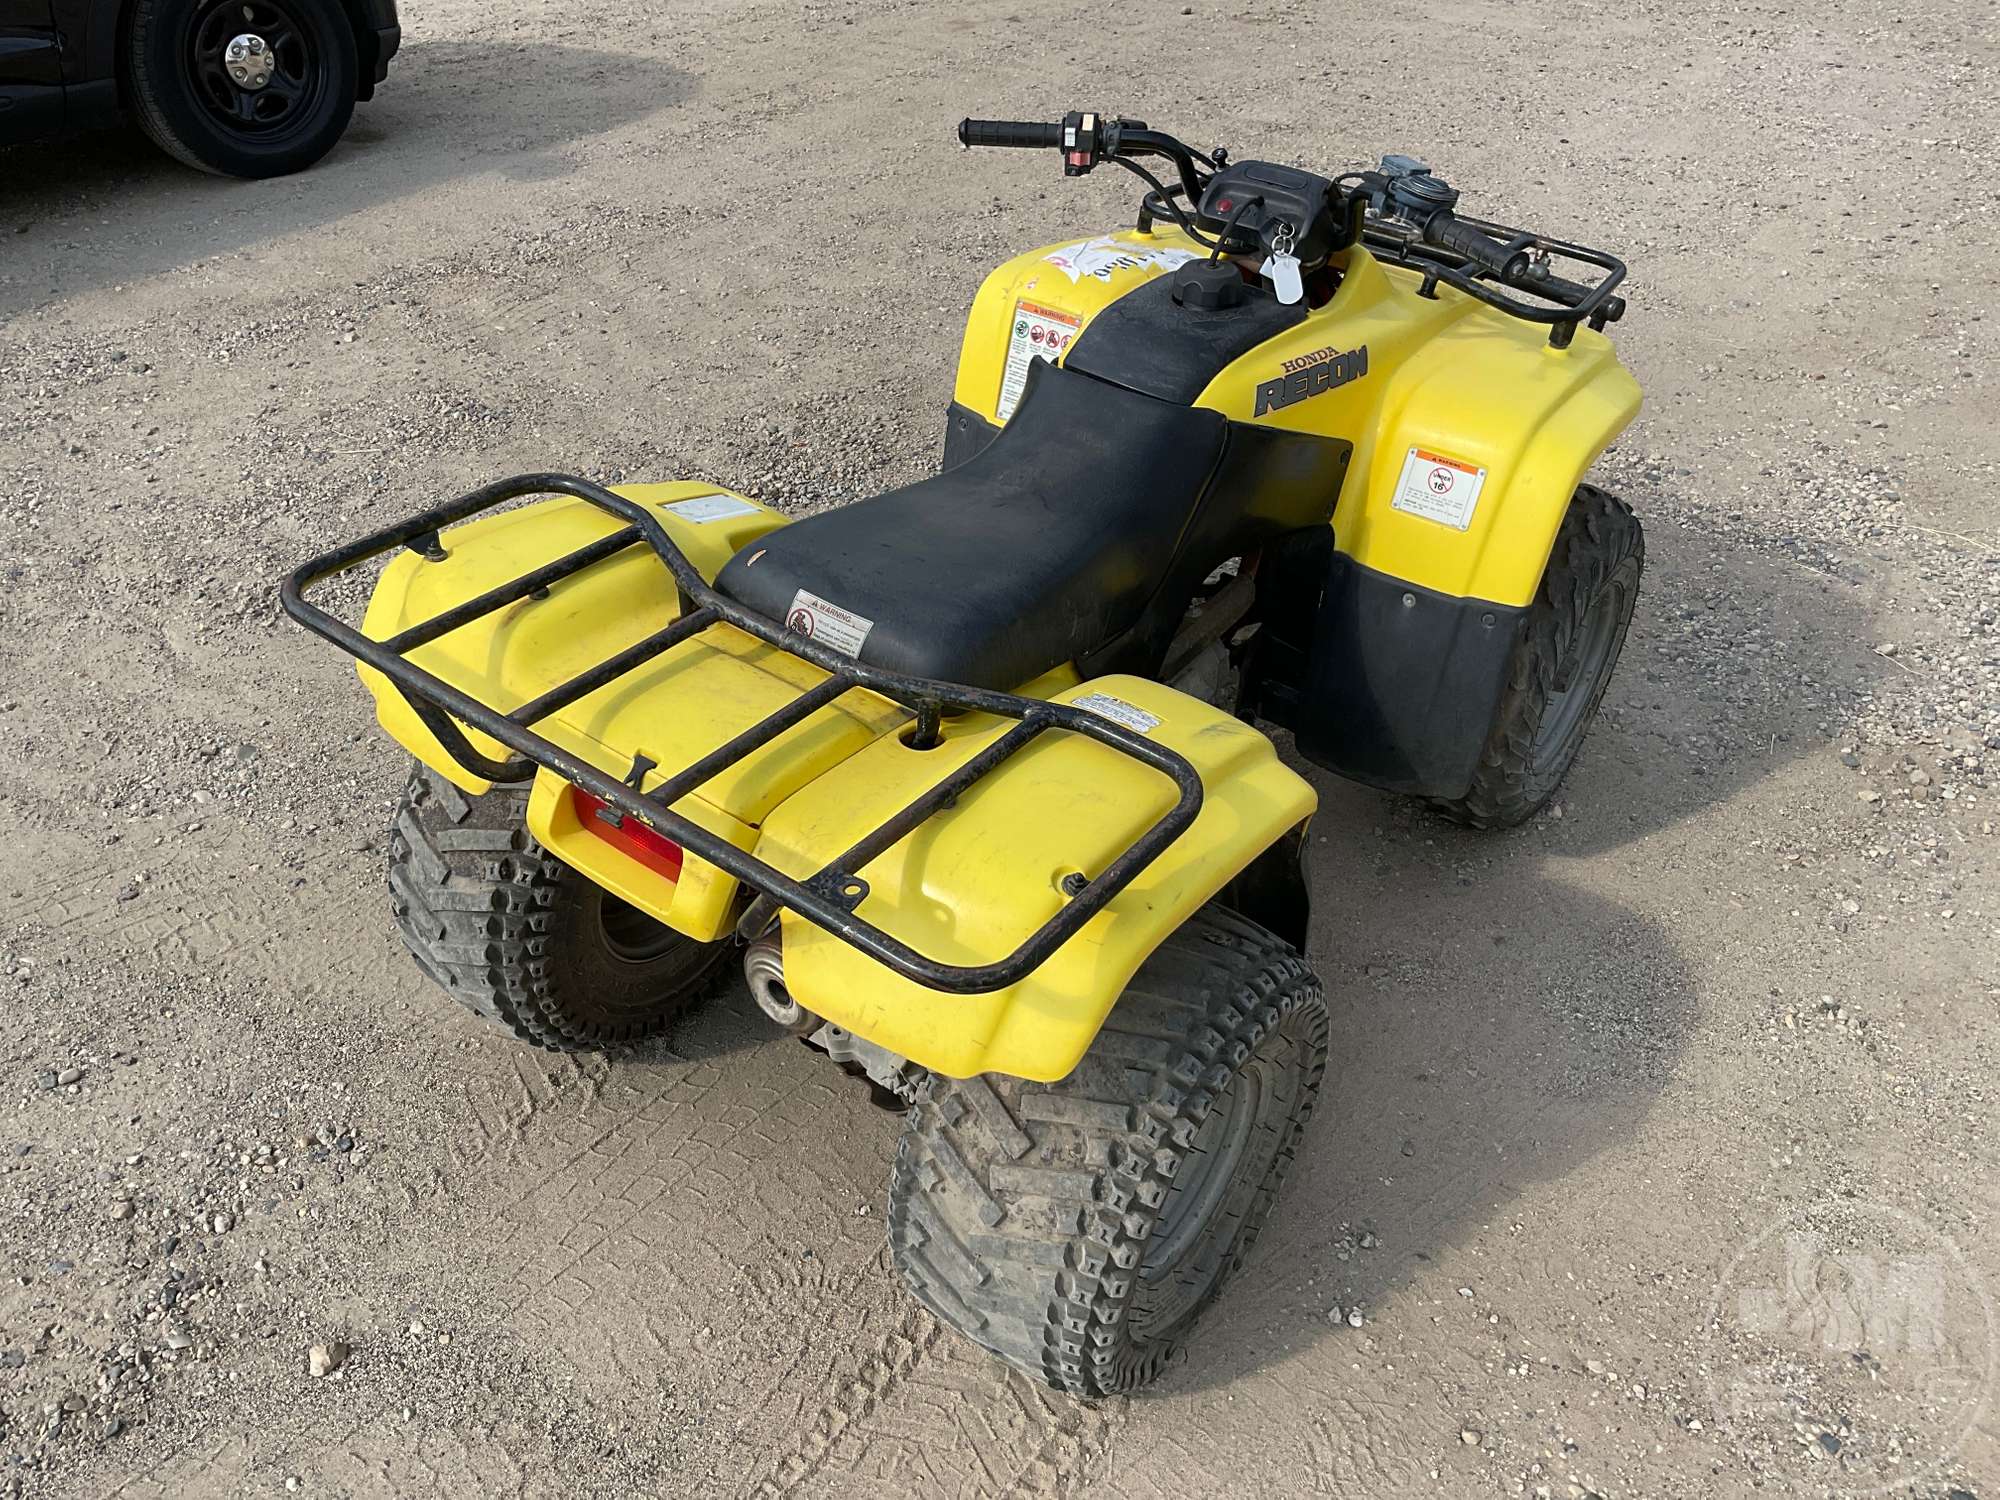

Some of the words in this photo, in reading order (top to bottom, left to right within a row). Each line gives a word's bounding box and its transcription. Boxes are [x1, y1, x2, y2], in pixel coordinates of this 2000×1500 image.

[1281, 346, 1340, 373] HONDA
[1253, 344, 1368, 418] RECON
[1433, 472, 1451, 482] UNDER
[1433, 482, 1445, 491] 16
[819, 602, 852, 623] WARNING
